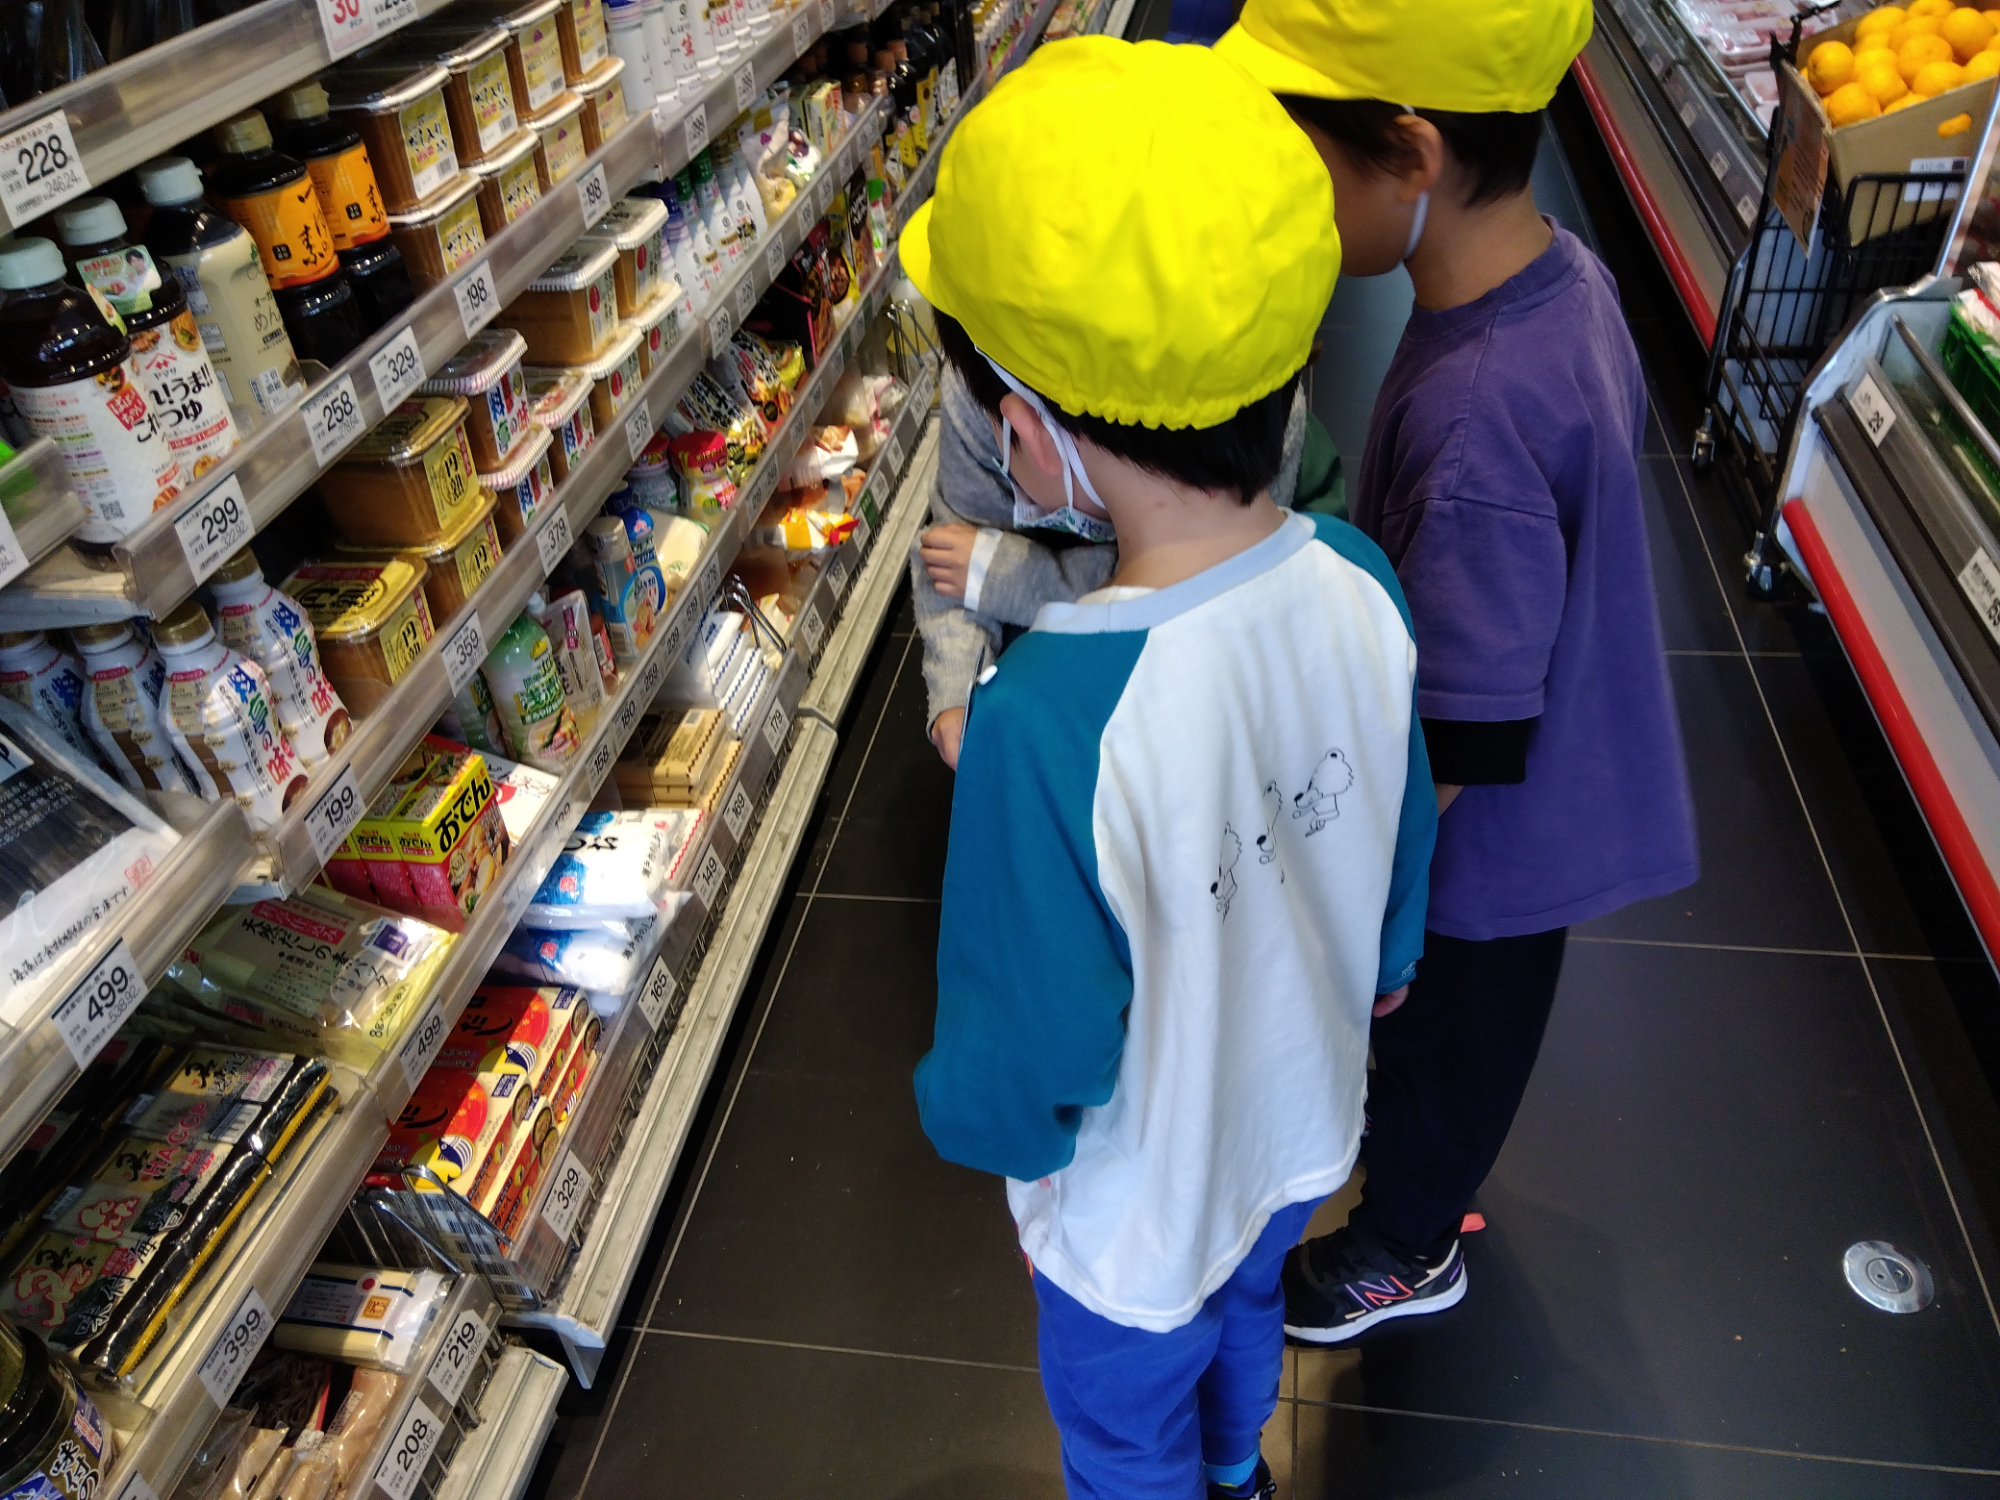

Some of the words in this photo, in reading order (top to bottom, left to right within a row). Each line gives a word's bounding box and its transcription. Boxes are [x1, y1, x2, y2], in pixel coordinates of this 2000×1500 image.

[18, 133, 68, 185] 228
[467, 276, 488, 312] 198
[388, 345, 415, 383] 329
[323, 391, 353, 433] 258
[201, 496, 239, 546] 299
[548, 518, 565, 549] 379
[457, 629, 479, 665] 359
[621, 700, 636, 730] 180
[324, 786, 354, 829] 199
[434, 777, 491, 853] おでん
[702, 857, 718, 886] 149
[88, 966, 129, 1023] 499
[651, 972, 668, 1002] 165
[416, 1014, 442, 1057] 499
[141, 1100, 207, 1177] HACCP
[557, 1166, 580, 1209] 329
[223, 1308, 261, 1365] 399
[447, 1321, 476, 1368] 219
[396, 1418, 427, 1471] 208
